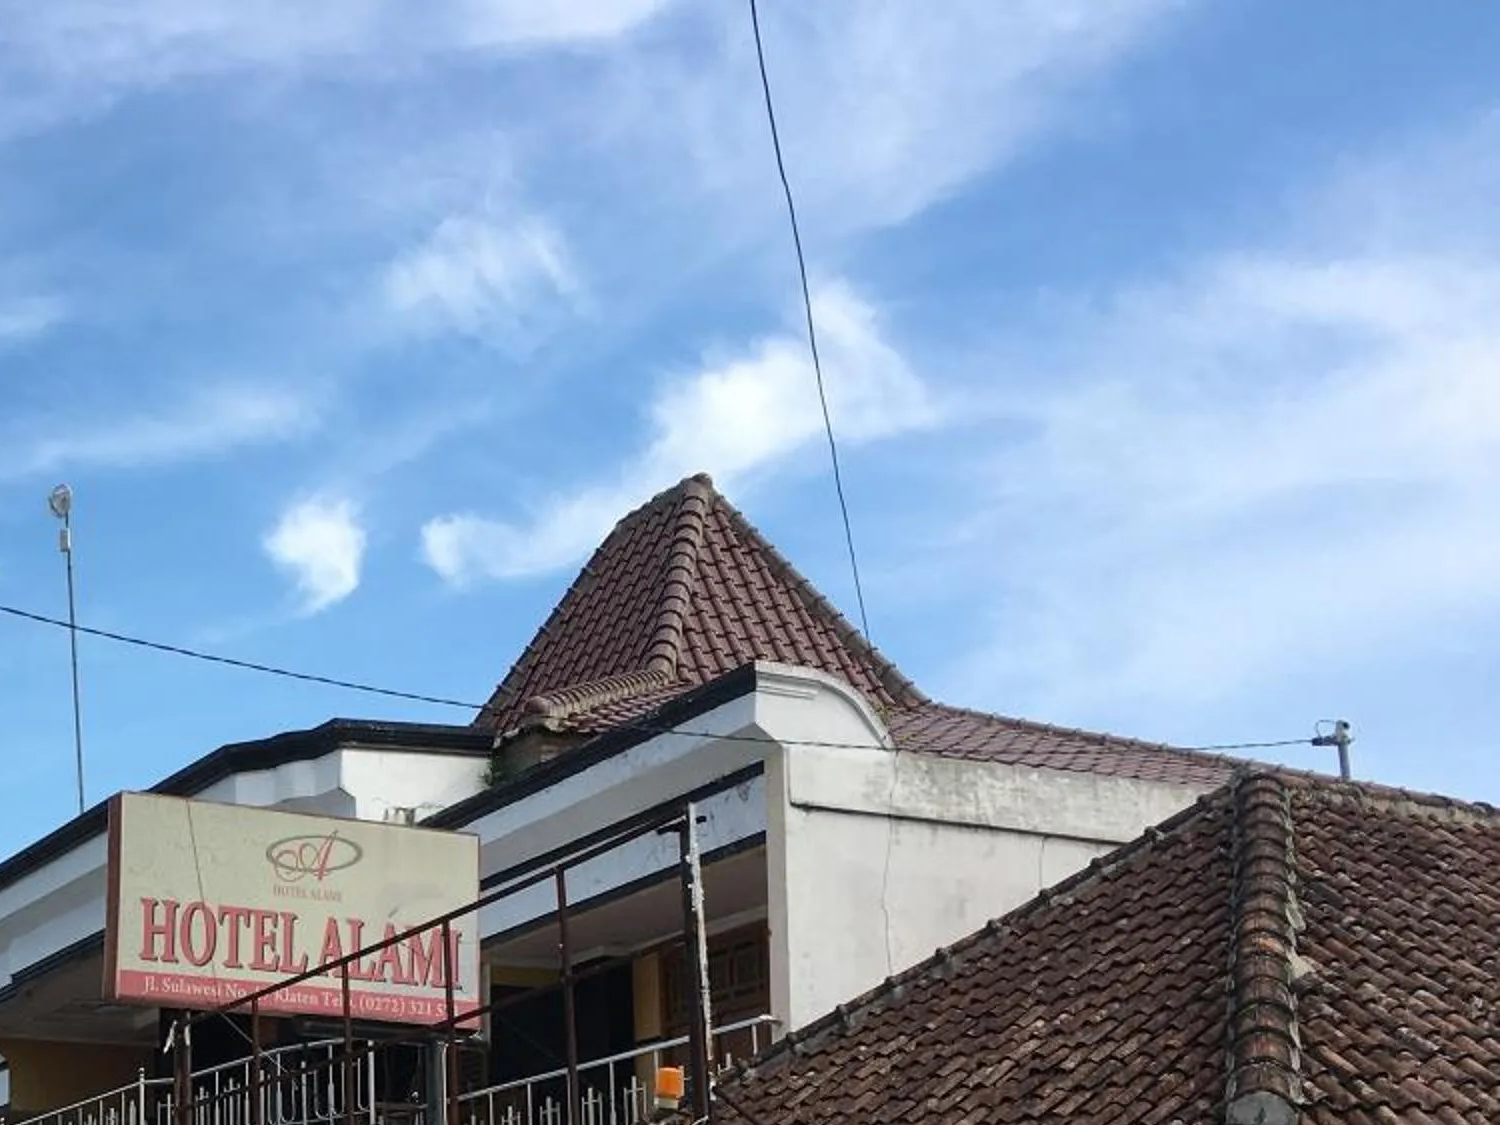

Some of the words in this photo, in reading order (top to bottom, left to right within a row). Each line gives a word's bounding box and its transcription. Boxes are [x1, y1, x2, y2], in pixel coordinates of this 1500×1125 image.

[272, 884, 308, 899] HOTEL
[138, 895, 308, 975] HOTEL
[161, 976, 221, 996] Sulawesi
[358, 996, 405, 1014] (0272)
